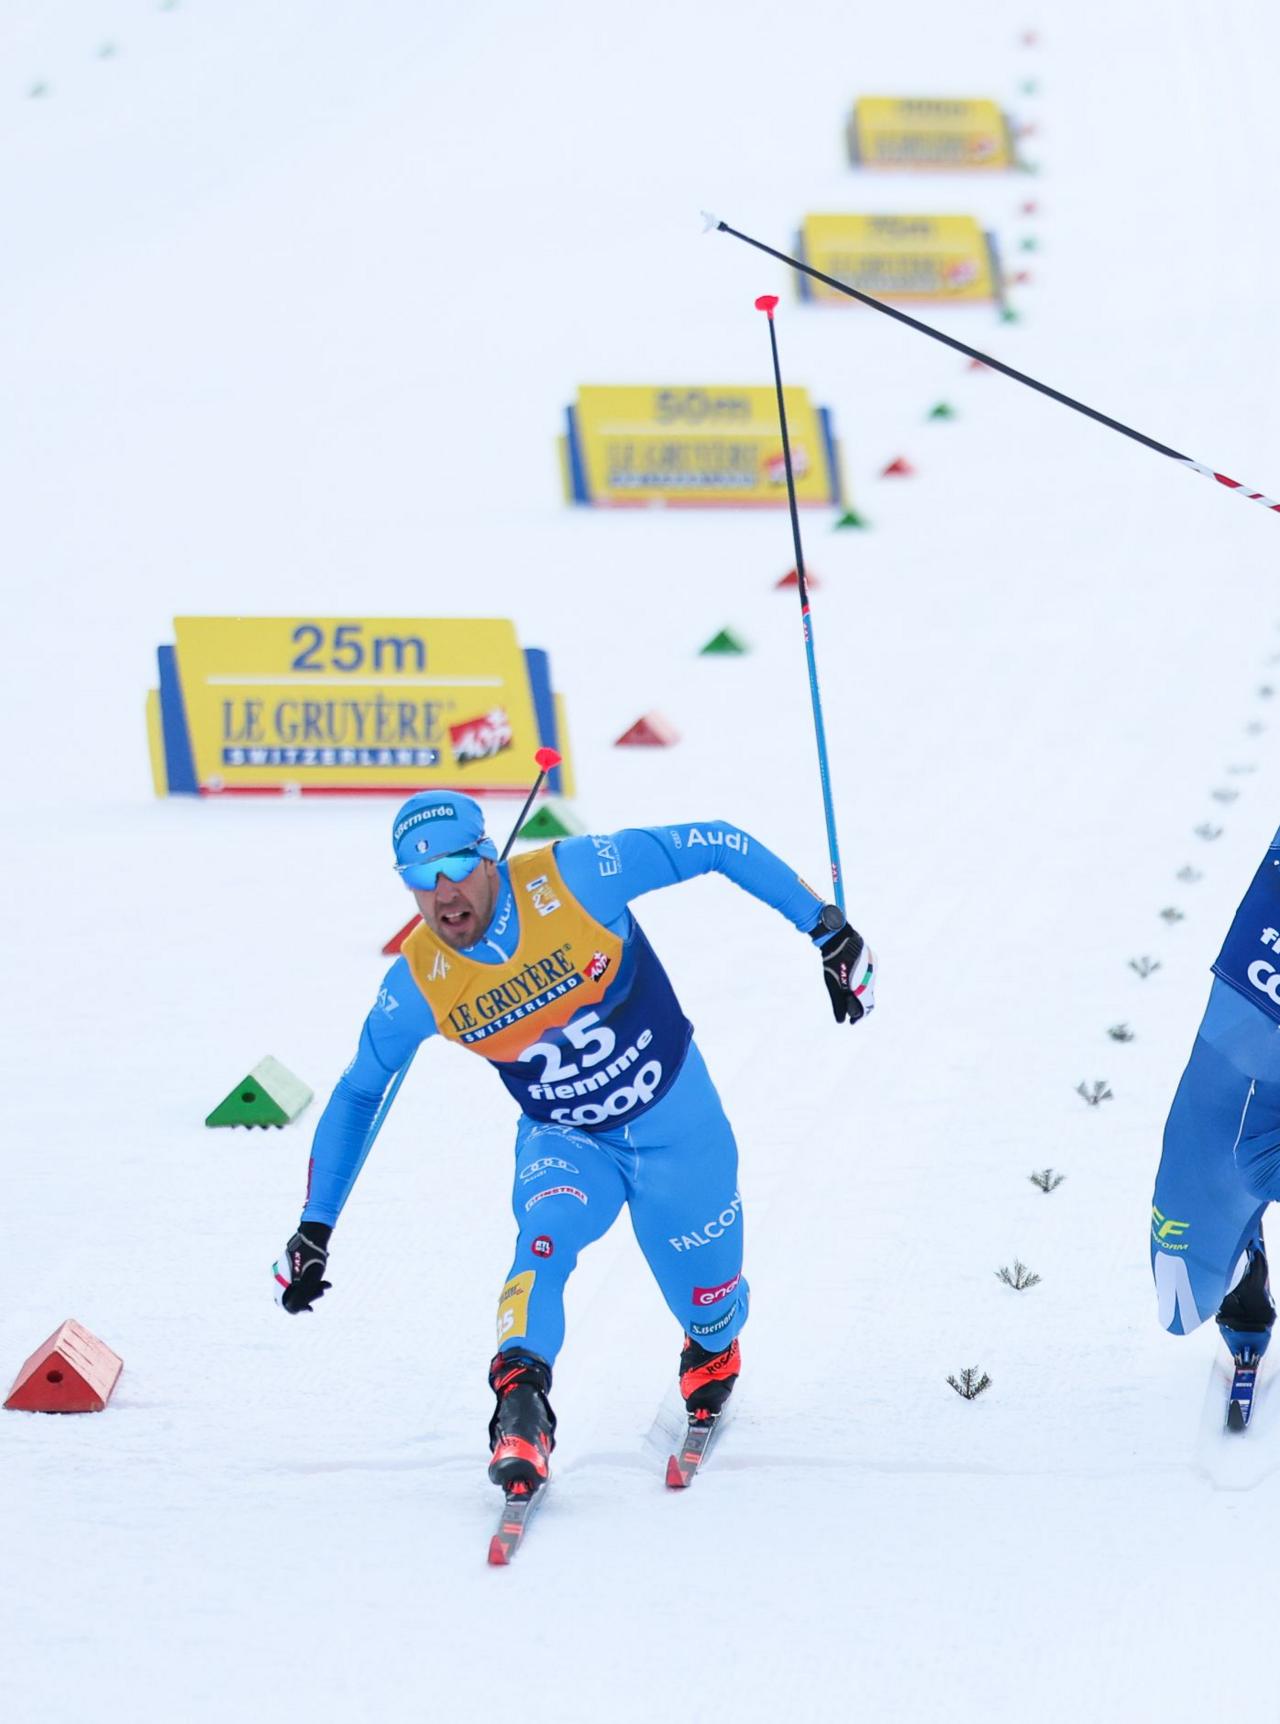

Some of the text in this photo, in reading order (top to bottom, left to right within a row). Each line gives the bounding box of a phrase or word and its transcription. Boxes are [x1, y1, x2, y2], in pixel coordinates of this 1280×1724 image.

[291, 624, 426, 673] 25m
[222, 698, 263, 742] LE
[229, 749, 435, 767] SWITZERLAND
[687, 828, 749, 856] Audi
[448, 1003, 477, 1032] LE
[465, 978, 578, 1043] SWITZERLAND
[517, 1011, 616, 1083] 25
[528, 1029, 653, 1100] fiemme
[551, 1060, 662, 1126] coop
